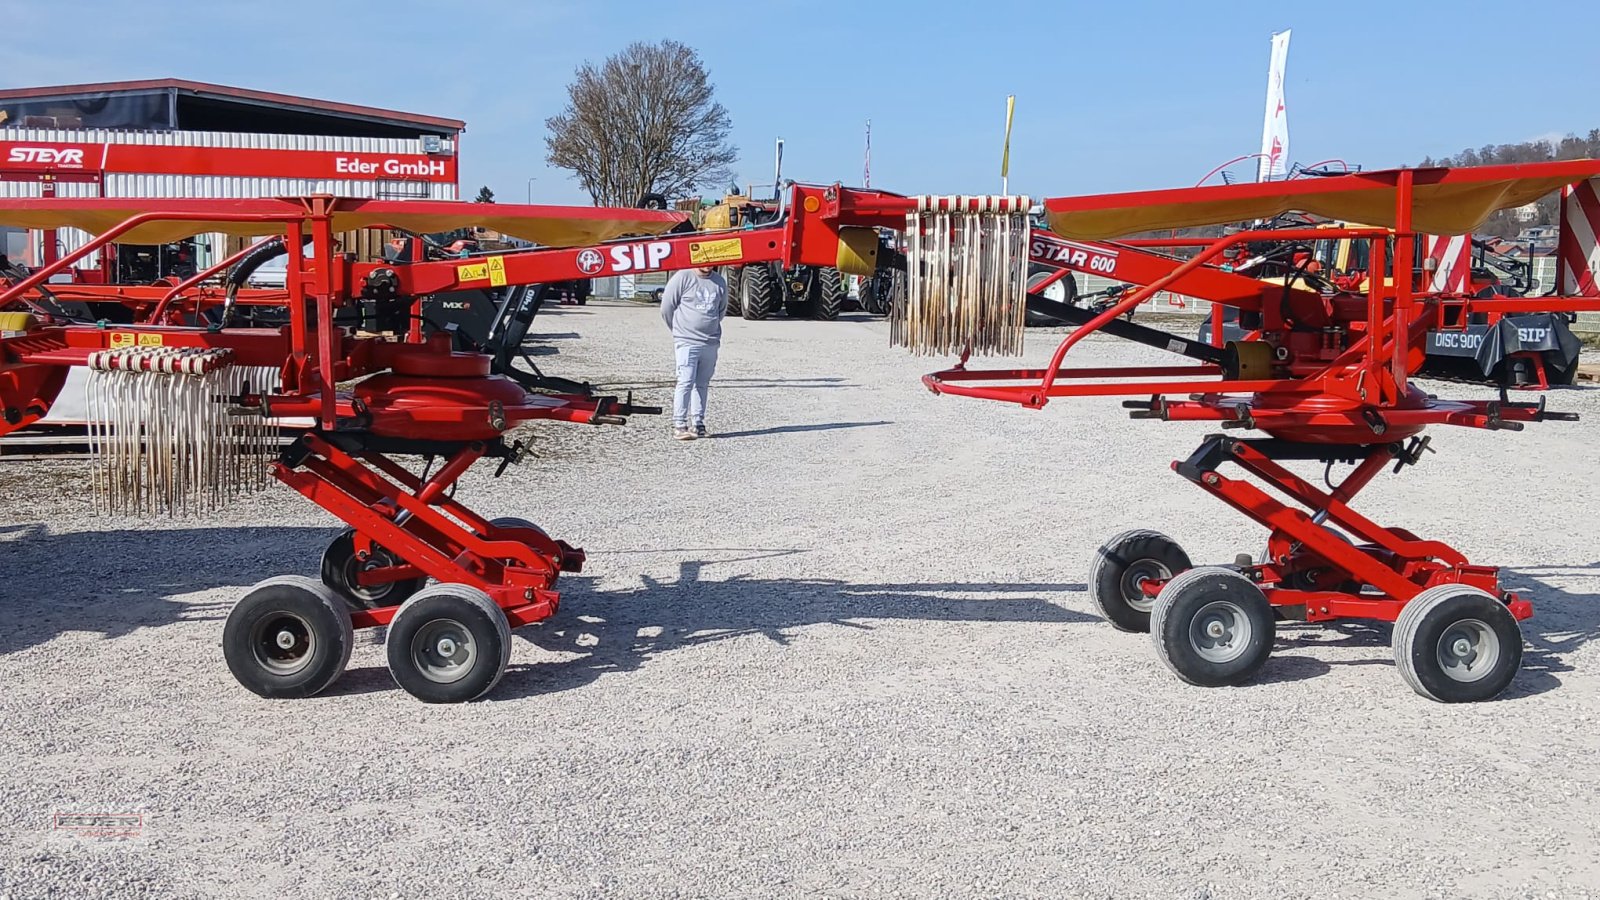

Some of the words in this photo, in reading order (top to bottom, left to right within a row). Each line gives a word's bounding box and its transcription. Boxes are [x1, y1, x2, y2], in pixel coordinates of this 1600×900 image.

[7, 147, 84, 163] STEYR
[335, 157, 380, 174] Eder
[383, 159, 445, 176] GmbH
[610, 241, 672, 272] SIP
[1029, 241, 1088, 268] STAR
[1090, 255, 1116, 273] 600
[1435, 332, 1459, 348] DISC
[1517, 327, 1546, 343] SIP
